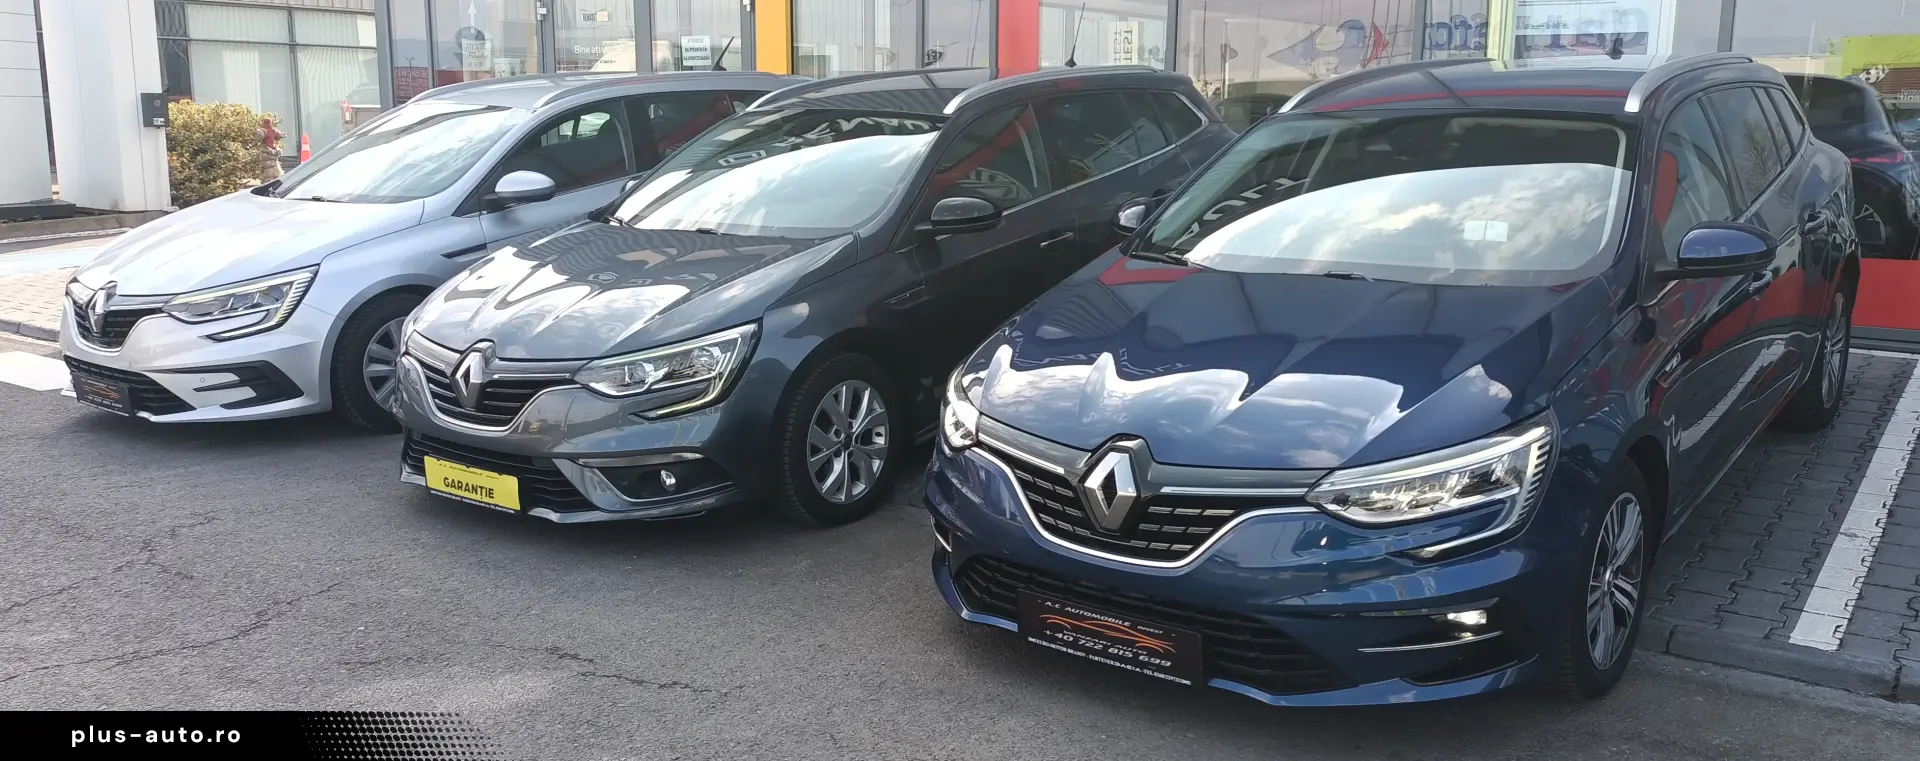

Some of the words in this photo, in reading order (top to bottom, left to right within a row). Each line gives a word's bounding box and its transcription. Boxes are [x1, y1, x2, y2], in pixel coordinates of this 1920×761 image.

[574, 44, 590, 54] Bine
[443, 476, 495, 500] GARANȚIE
[1044, 601, 1062, 609] A.C
[1064, 606, 1132, 627] AUTOMOBILE
[1137, 625, 1164, 634] INVEST
[1043, 629, 1074, 642] +40
[1078, 638, 1104, 650] 722
[1107, 647, 1133, 658] 815
[1138, 655, 1172, 667] 699
[1114, 644, 1148, 655] AUTO
